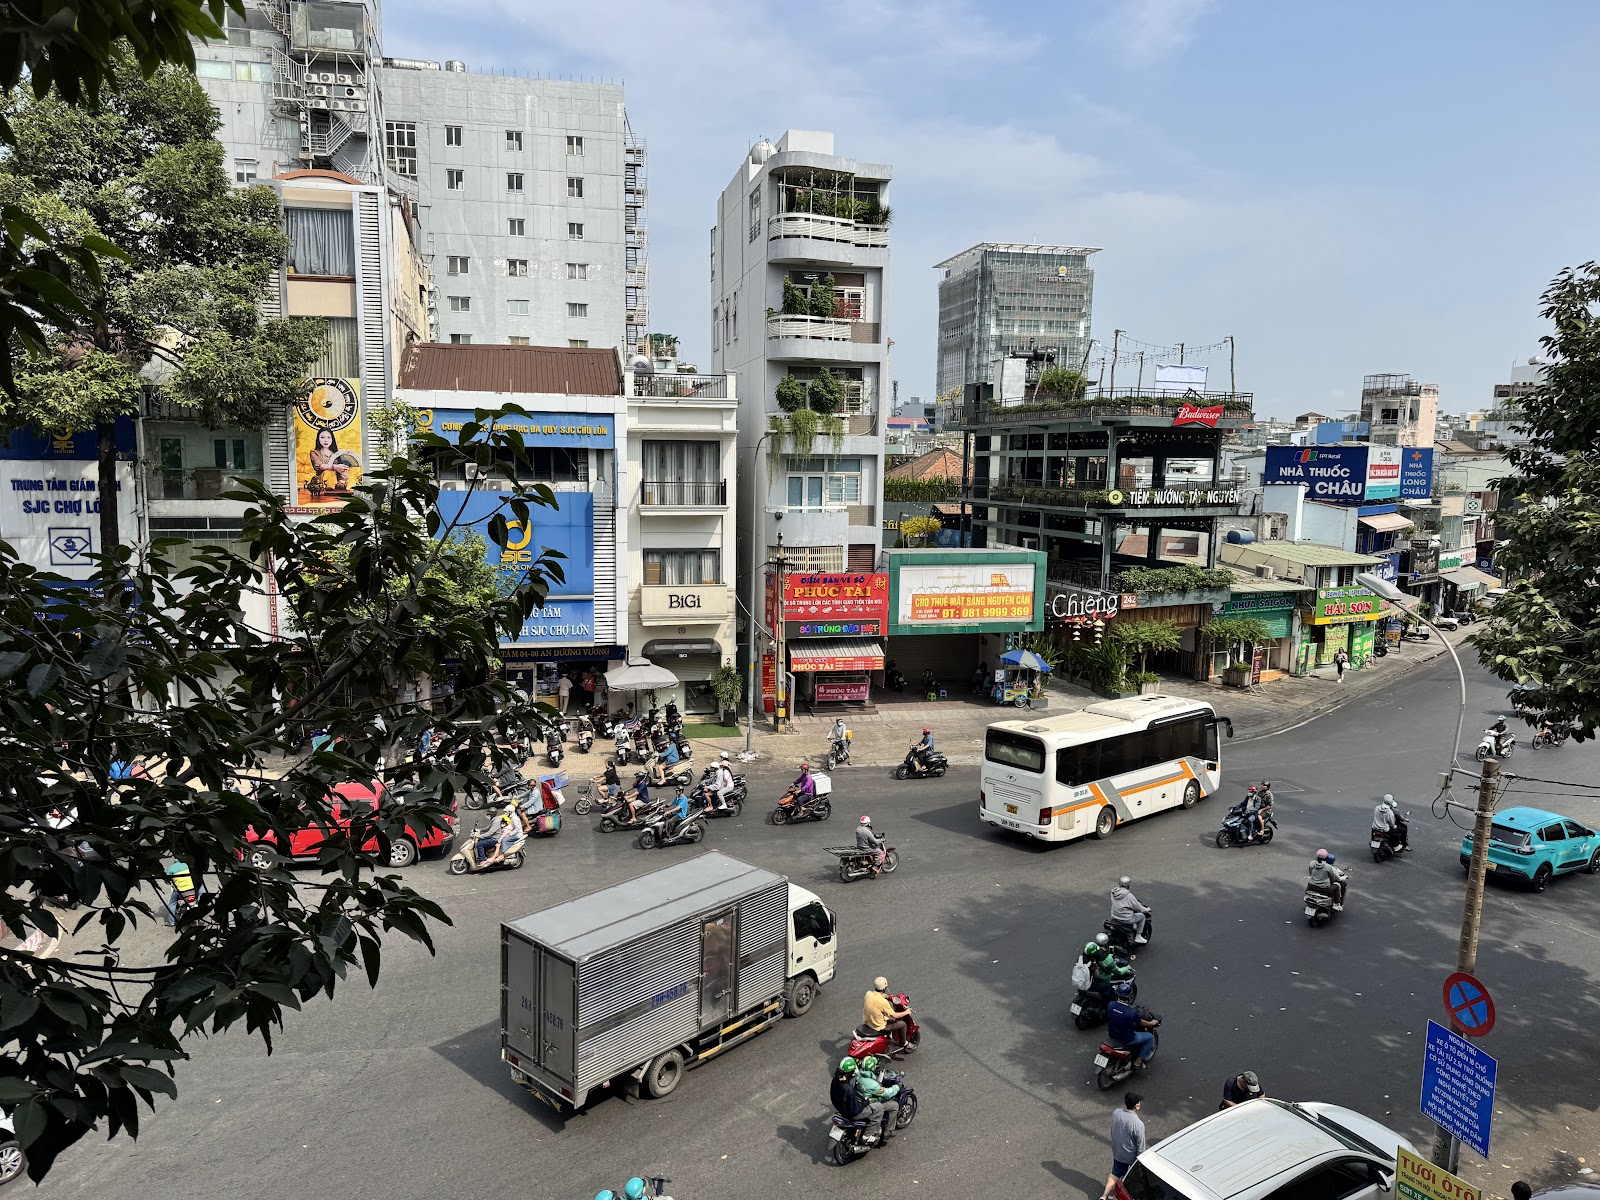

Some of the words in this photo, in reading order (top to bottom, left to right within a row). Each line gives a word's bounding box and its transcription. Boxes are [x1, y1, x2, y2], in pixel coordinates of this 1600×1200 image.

[1178, 406, 1220, 419] Budweiser
[560, 425, 575, 434] SJC
[1280, 465, 1304, 476] NHÀ
[1310, 464, 1350, 478] THUỐC
[10, 480, 44, 491] TRUNG
[46, 478, 67, 491] TÂM
[70, 478, 96, 492] GIÁM
[1315, 480, 1362, 496] CHÂU
[1402, 486, 1426, 495] CHÂU
[1207, 488, 1240, 504] NGUYÊN
[22, 500, 50, 514] SJC
[54, 500, 82, 516] CHỢ
[500, 550, 532, 564] SJC
[854, 574, 866, 583] SỐ
[794, 584, 838, 598] PHÚC
[844, 584, 872, 597] TÀI
[668, 594, 702, 608] BiGi
[914, 598, 929, 607] CHO
[931, 596, 948, 606] THUÊ
[987, 595, 1015, 606] NGUYÊN
[1052, 594, 1118, 618] Chiêng
[1123, 596, 1136, 604] 242
[1260, 597, 1293, 608] SAIGON
[540, 606, 561, 618] TÂM
[962, 608, 980, 618] 081
[982, 608, 1008, 617] 9999
[1010, 607, 1030, 616] 369
[1326, 600, 1346, 615] HẢI
[1350, 601, 1372, 612] SƠN
[531, 626, 548, 636] SJC
[549, 624, 569, 638] CHỢ
[571, 623, 590, 636] LỚN
[800, 624, 812, 633] SỐ
[814, 624, 842, 633] TRÚNG
[842, 624, 860, 634] ĐẶC
[500, 648, 518, 658] TÂM
[554, 648, 581, 657] DƯƠNG
[583, 647, 610, 656] VƯƠNG
[793, 663, 816, 671] PHÚC
[1449, 1035, 1465, 1050] NGOẠI
[1436, 1038, 1444, 1046] XE
[1449, 1045, 1456, 1054] TÔ
[1457, 1050, 1468, 1062] ĐẾN
[1428, 1043, 1436, 1051] XE
[1436, 1047, 1444, 1057] TẢI
[1475, 1073, 1493, 1088] XUỐNG
[1436, 1067, 1451, 1080] CÔNG
[1452, 1077, 1467, 1092] NGHỆ
[1467, 1087, 1481, 1100] THEO
[1438, 1078, 1451, 1092] NGHỊ
[1452, 1088, 1469, 1102] QUYẾT
[1469, 1099, 1478, 1108] SỐ
[1432, 1093, 1446, 1106] NGÀY
[1469, 1119, 1479, 1131] CỦA
[1424, 1107, 1441, 1124] THÀNH
[1442, 1120, 1454, 1132] PHỐ
[1454, 1129, 1462, 1138] HỒ
[1463, 1136, 1472, 1145] CHÍ
[1472, 1143, 1485, 1156] MINH
[1454, 1119, 1469, 1134] NHÂN
[1470, 1131, 1482, 1143] DÂN
[1401, 1155, 1436, 1185] TƯƠI
[1401, 1171, 1415, 1184] TRANG
